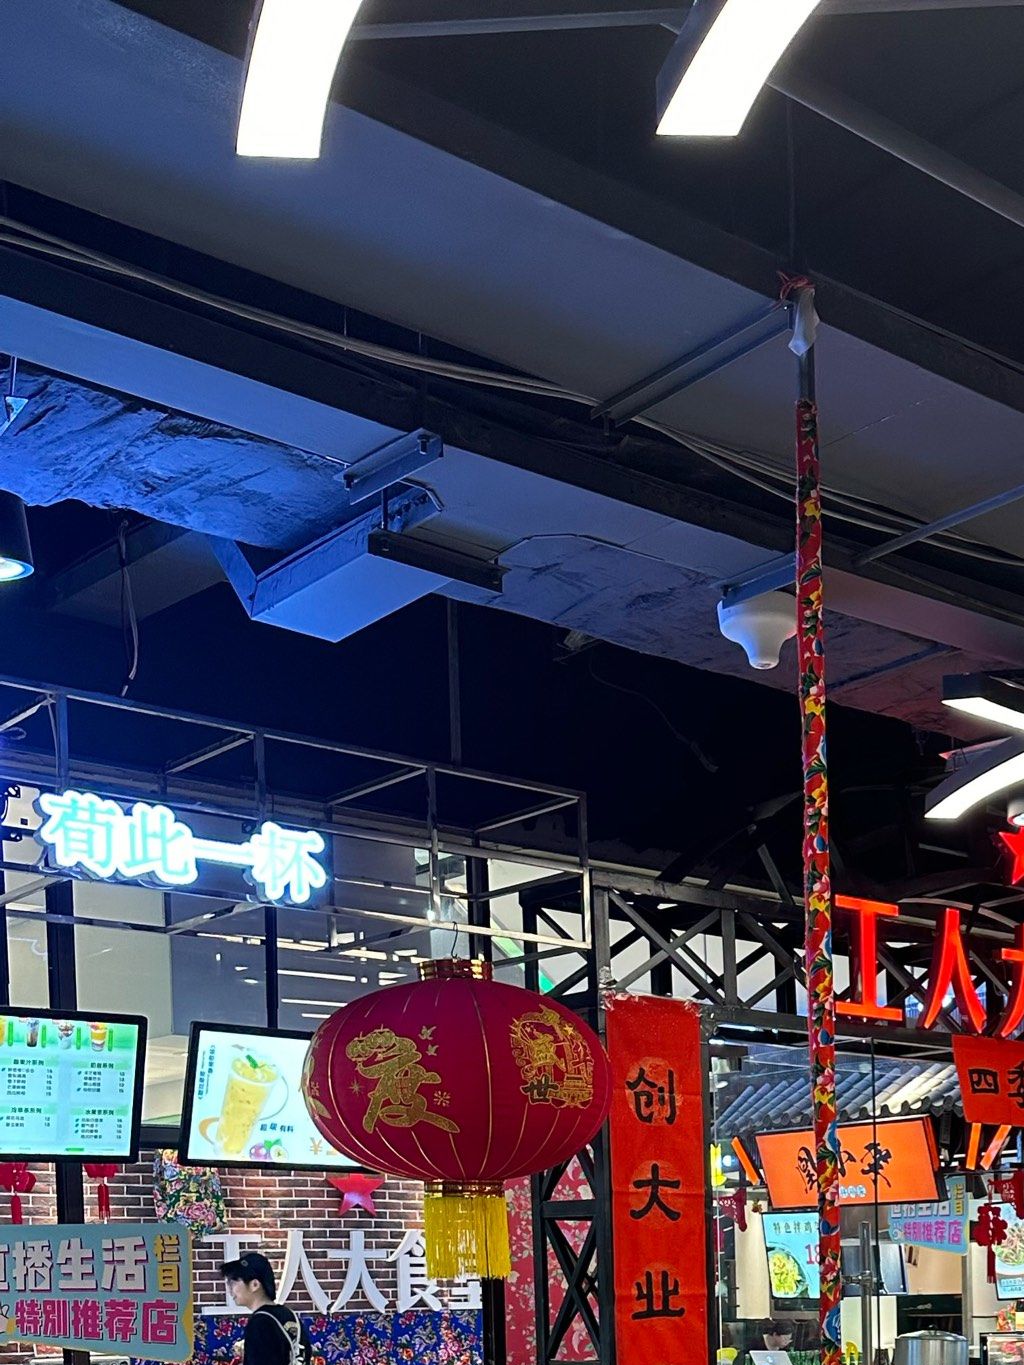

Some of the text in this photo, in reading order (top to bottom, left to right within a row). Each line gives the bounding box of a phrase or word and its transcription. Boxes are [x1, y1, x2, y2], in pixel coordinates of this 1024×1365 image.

[15, 1299, 178, 1344] 特别推荐店
